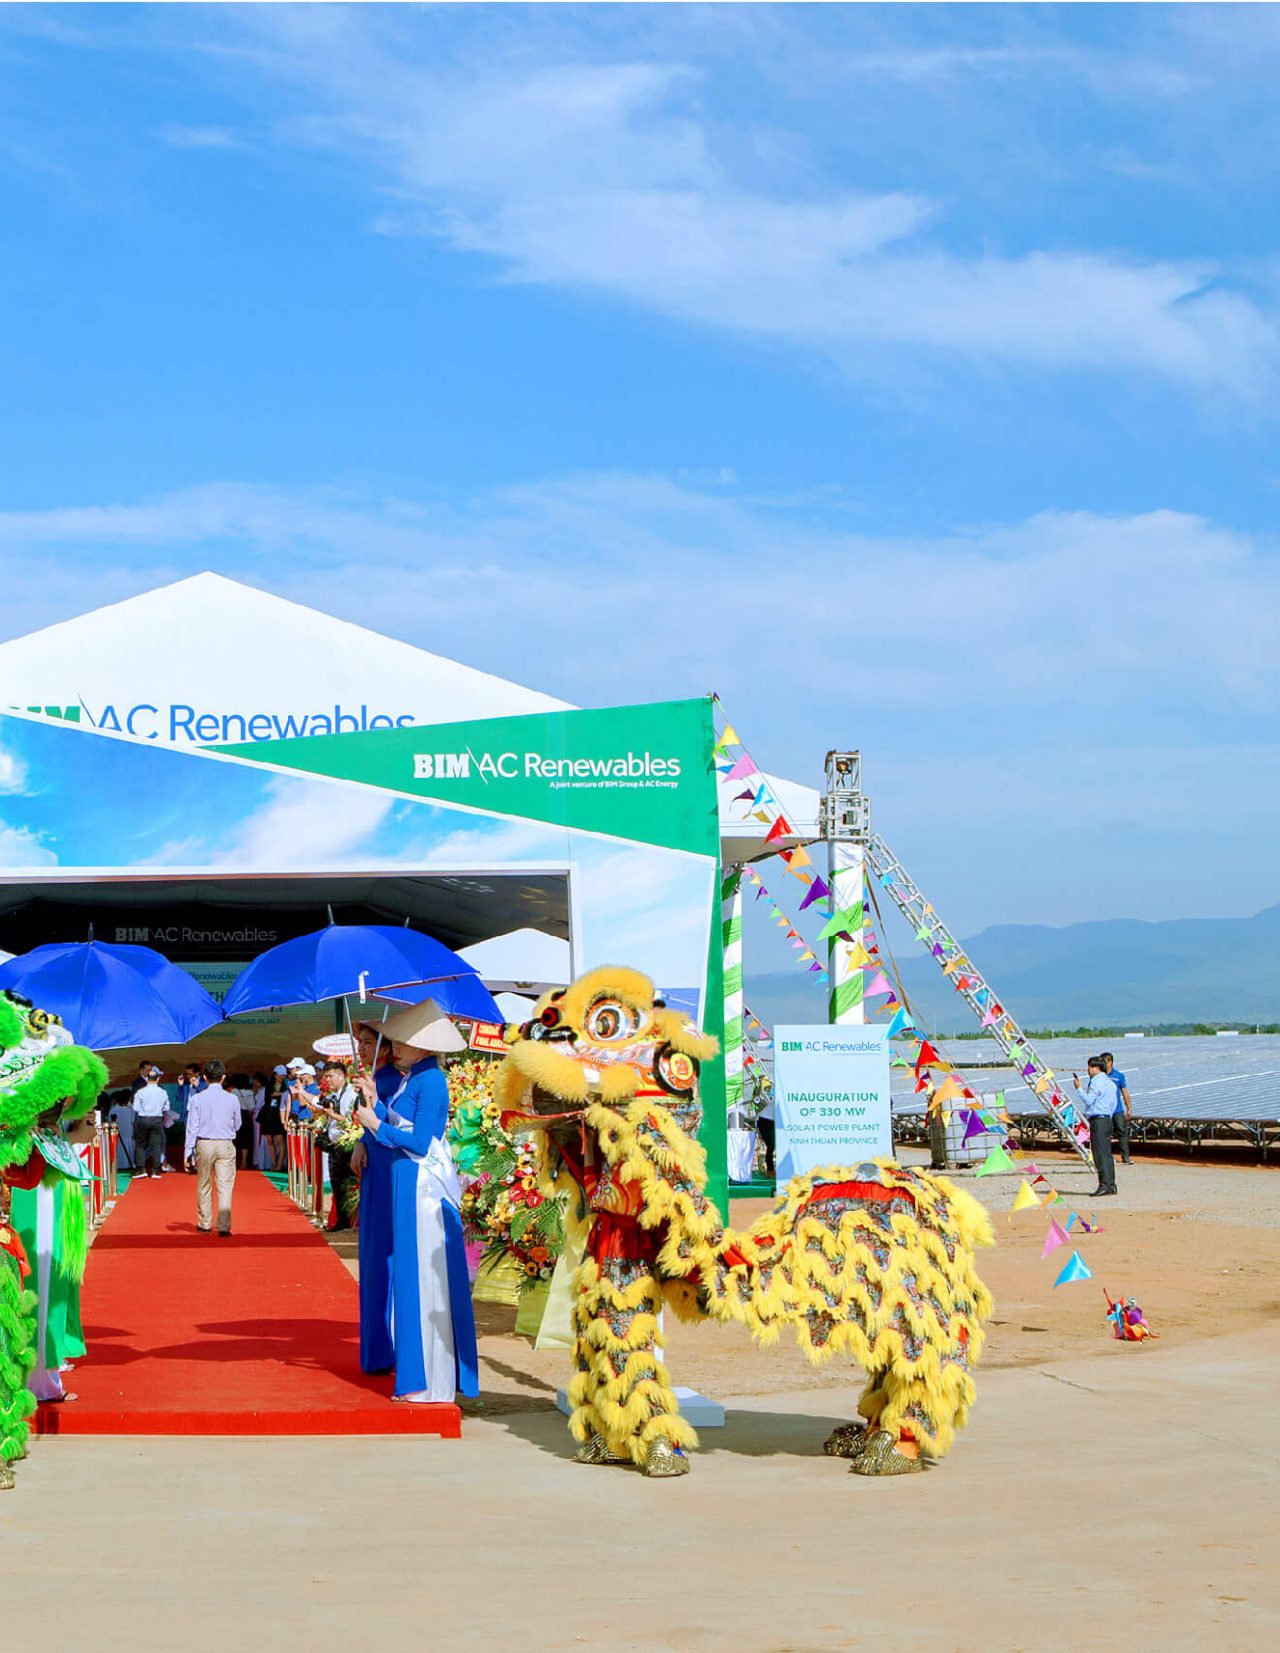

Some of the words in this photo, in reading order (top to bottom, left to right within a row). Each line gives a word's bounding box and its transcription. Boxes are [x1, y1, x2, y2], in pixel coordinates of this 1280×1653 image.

[413, 753, 470, 778] BIM
[479, 752, 519, 778] AC
[524, 752, 681, 777] Renewables
[619, 781, 639, 789] Group
[656, 780, 679, 789] Energy
[115, 927, 149, 942] BIM
[154, 927, 178, 942] AC
[182, 926, 277, 942] Renewables
[781, 1041, 803, 1052] BIM
[804, 1041, 821, 1052] AC
[823, 1041, 882, 1052] Renewables
[787, 1092, 879, 1102] INAUGURATION
[800, 1107, 816, 1117] OF
[819, 1107, 841, 1117] 330
[845, 1107, 866, 1117] MW
[818, 1124, 850, 1132] POWER
[852, 1123, 880, 1131] PLANT
[840, 1137, 879, 1145] PROVINCE
